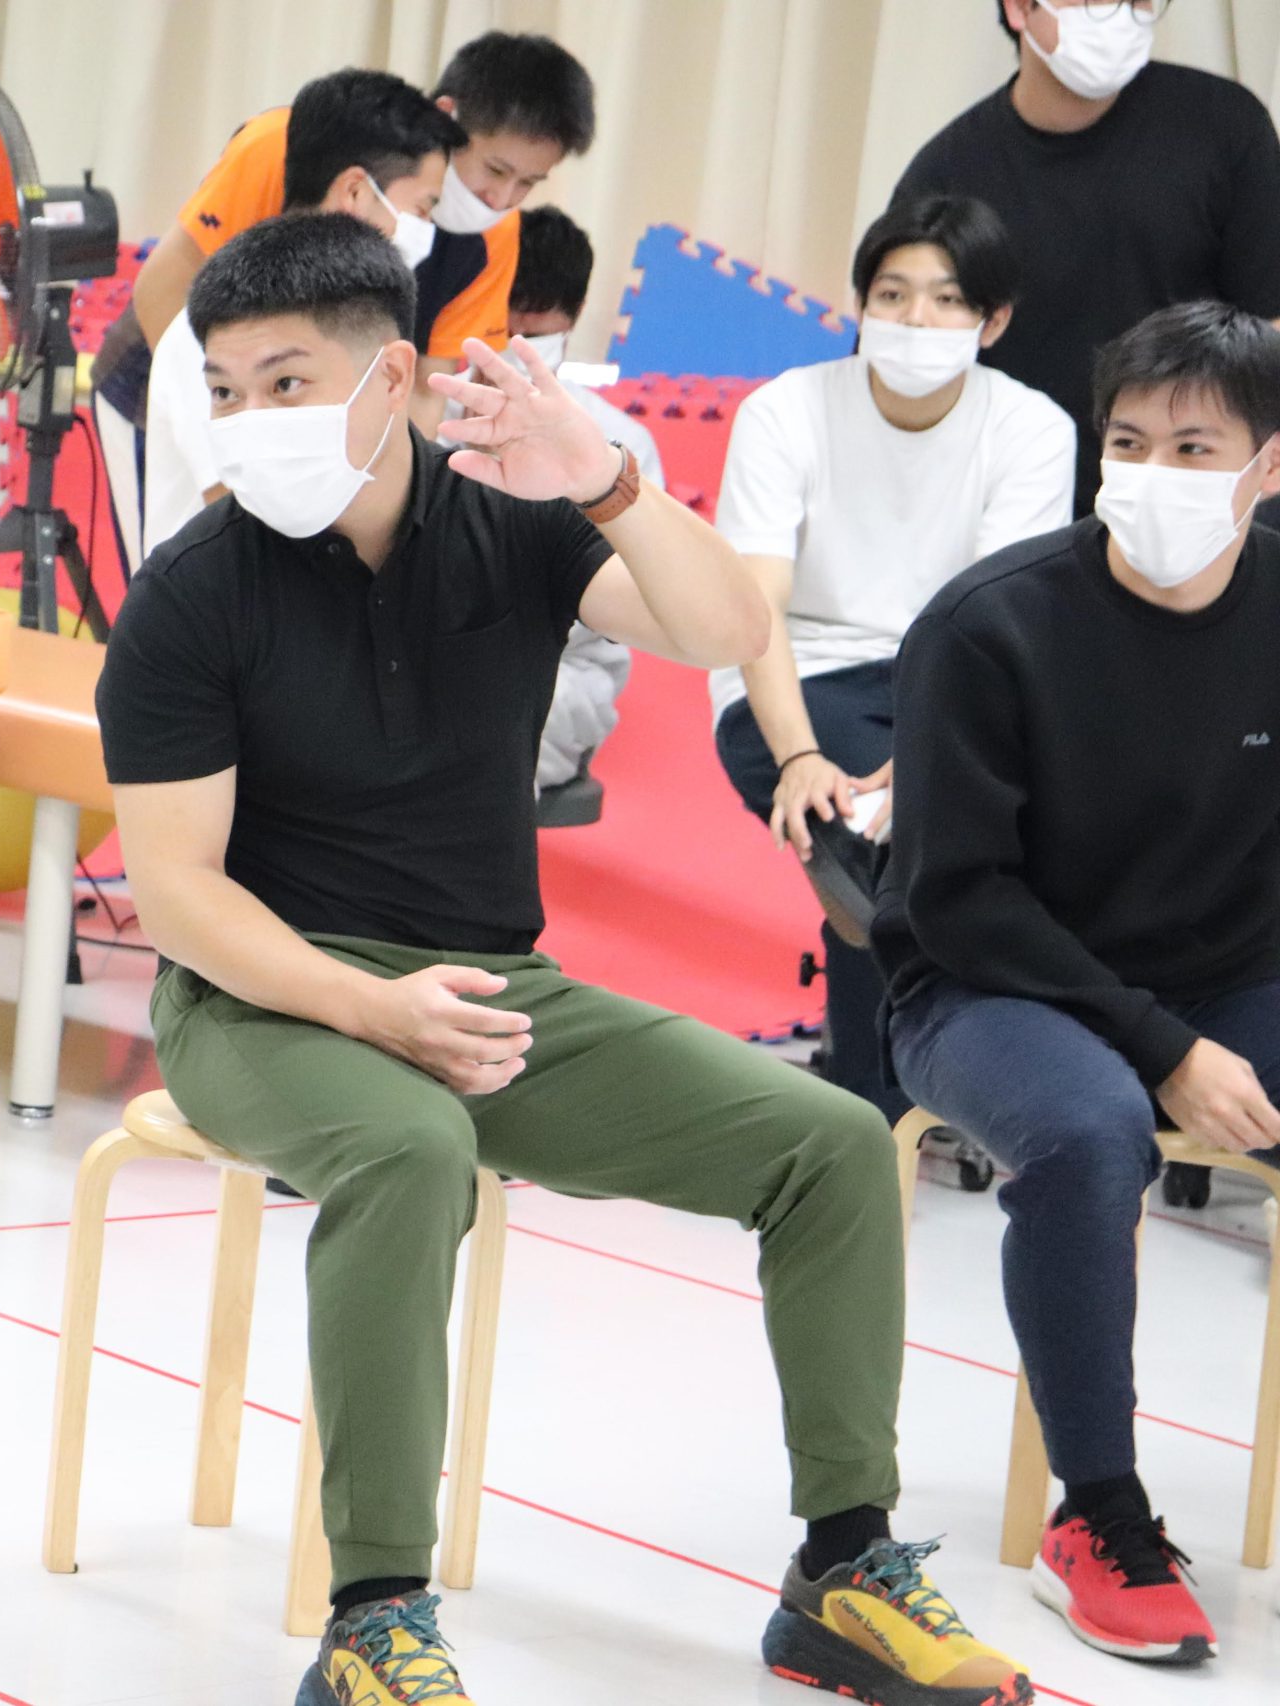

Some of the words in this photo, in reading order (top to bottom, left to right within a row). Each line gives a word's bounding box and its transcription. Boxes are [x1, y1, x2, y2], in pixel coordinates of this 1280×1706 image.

[1241, 731, 1271, 748] FILA
[839, 1596, 864, 1622] new
[864, 1618, 907, 1671] balance
